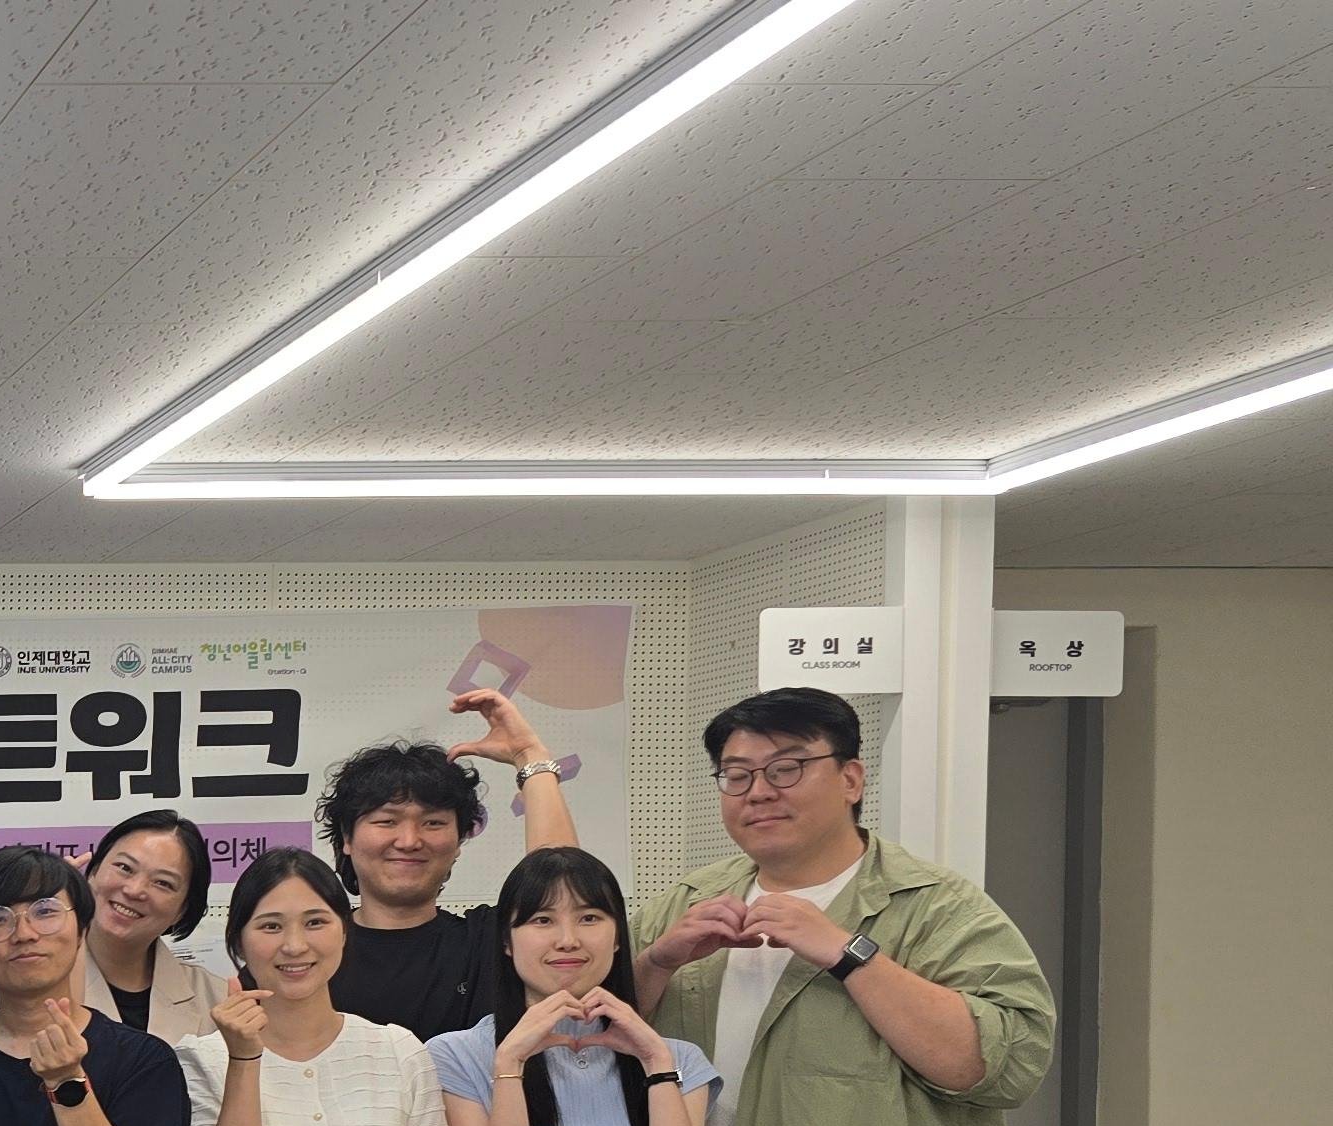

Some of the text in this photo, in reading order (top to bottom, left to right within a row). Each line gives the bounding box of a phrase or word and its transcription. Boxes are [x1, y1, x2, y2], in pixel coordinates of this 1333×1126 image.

[17, 649, 92, 667] 인제대학교
[199, 638, 307, 670] 청년어울림센터
[16, 664, 92, 675] INJE UNIVERSITY
[151, 665, 193, 674] CAMPUS
[801, 660, 861, 670] CLASS ROOM
[1028, 664, 1073, 672] ROOFTOP
